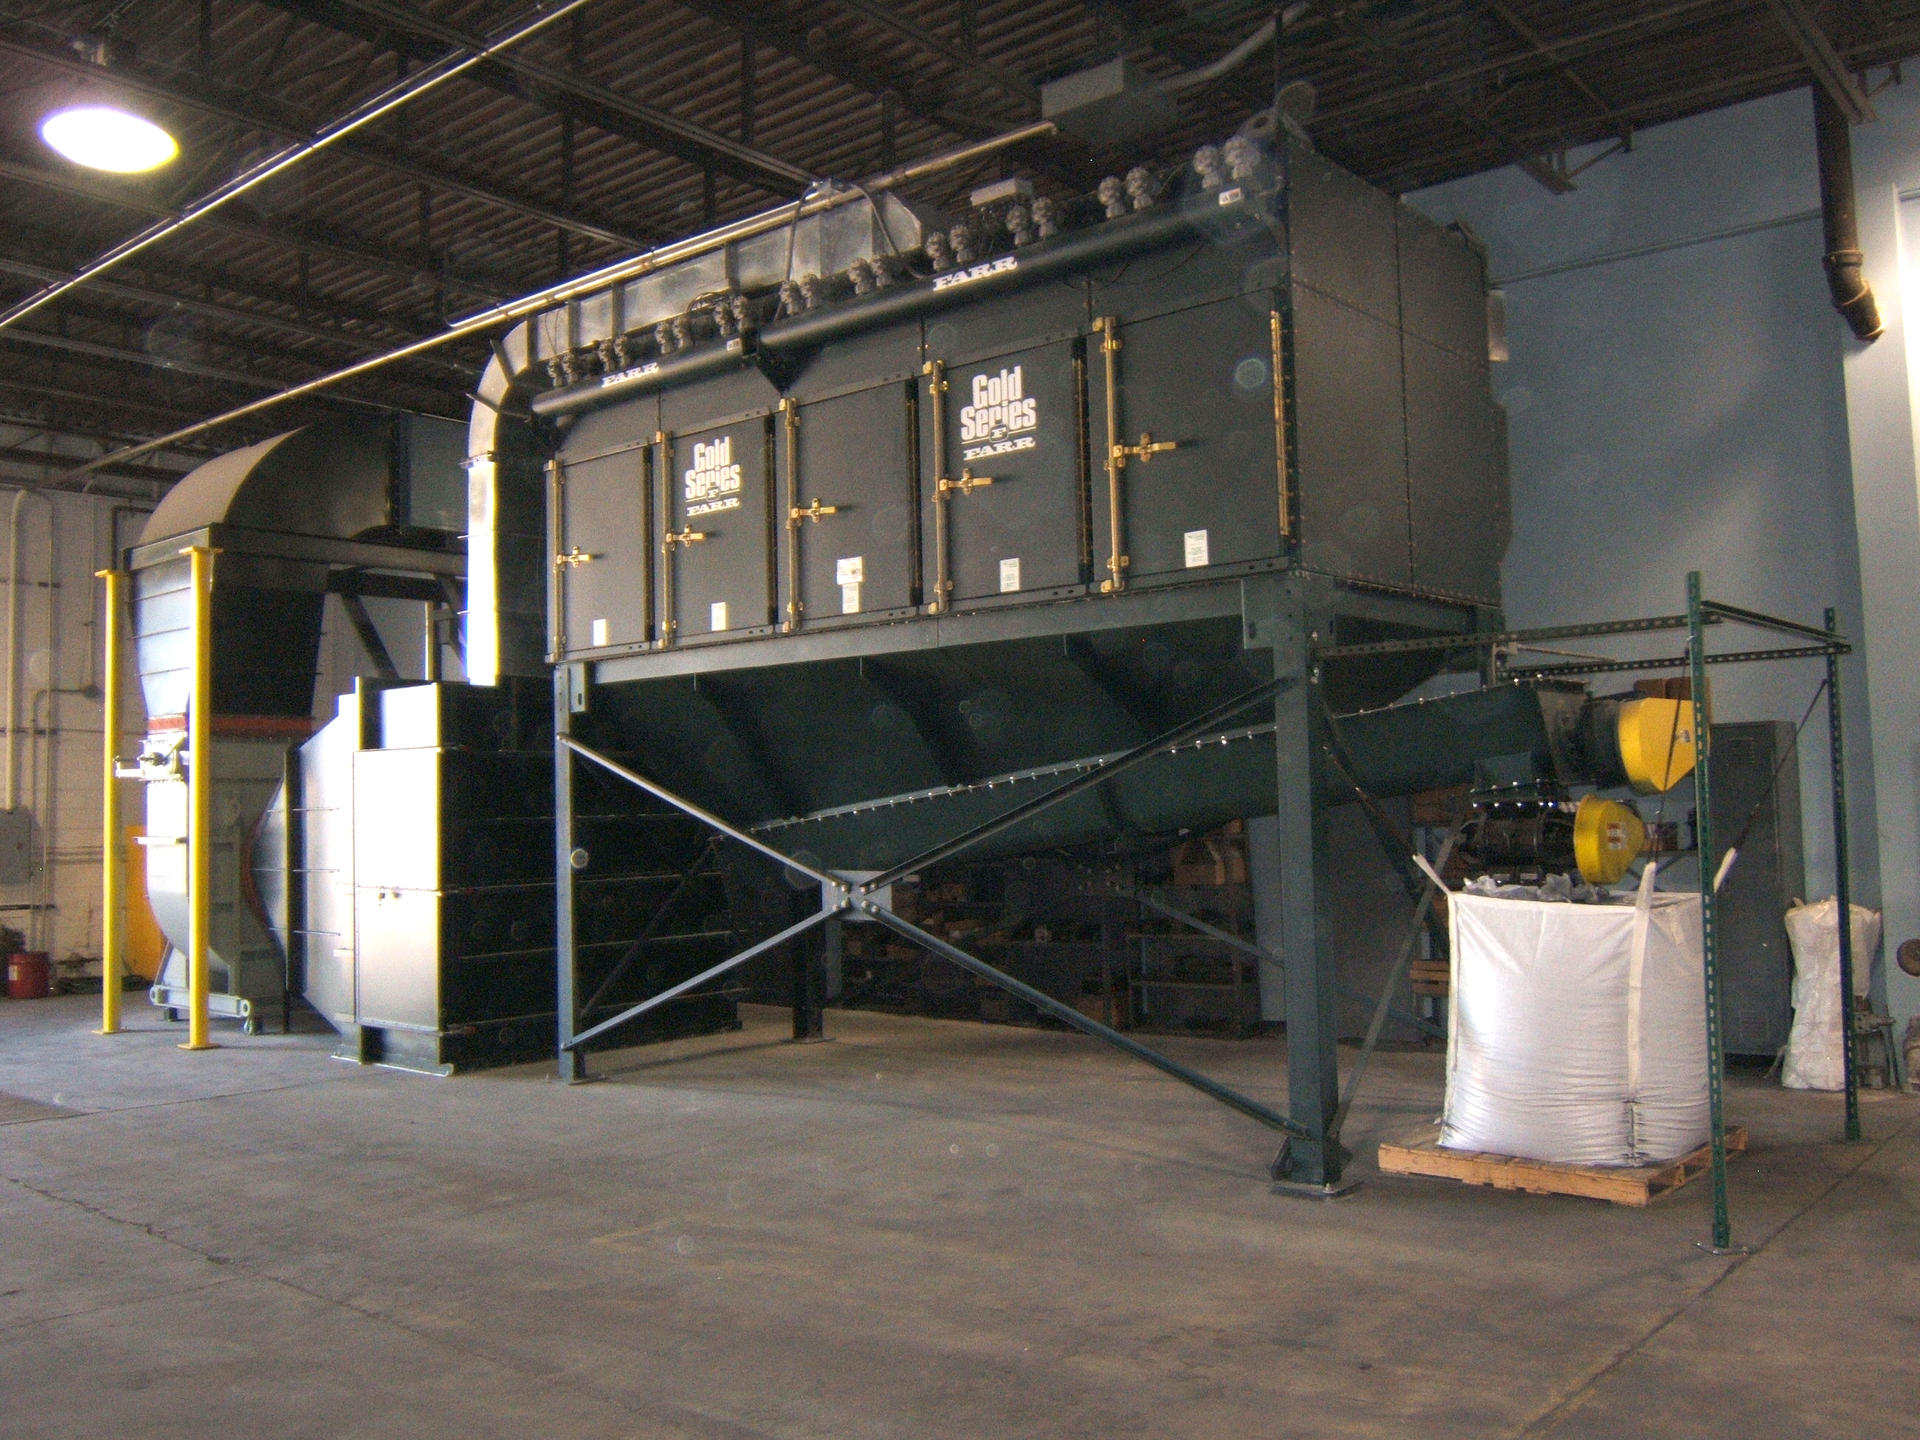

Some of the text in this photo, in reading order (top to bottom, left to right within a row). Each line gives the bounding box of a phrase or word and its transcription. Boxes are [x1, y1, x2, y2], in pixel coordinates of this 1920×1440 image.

[932, 256, 1018, 291] FARR
[601, 362, 659, 388] FARR
[972, 365, 1022, 409] Gold
[960, 398, 1037, 440] Series
[991, 427, 1006, 439] F
[693, 436, 730, 472] Gold
[963, 436, 1036, 461] FARR
[685, 464, 741, 499] Series
[686, 497, 740, 516] FARR
